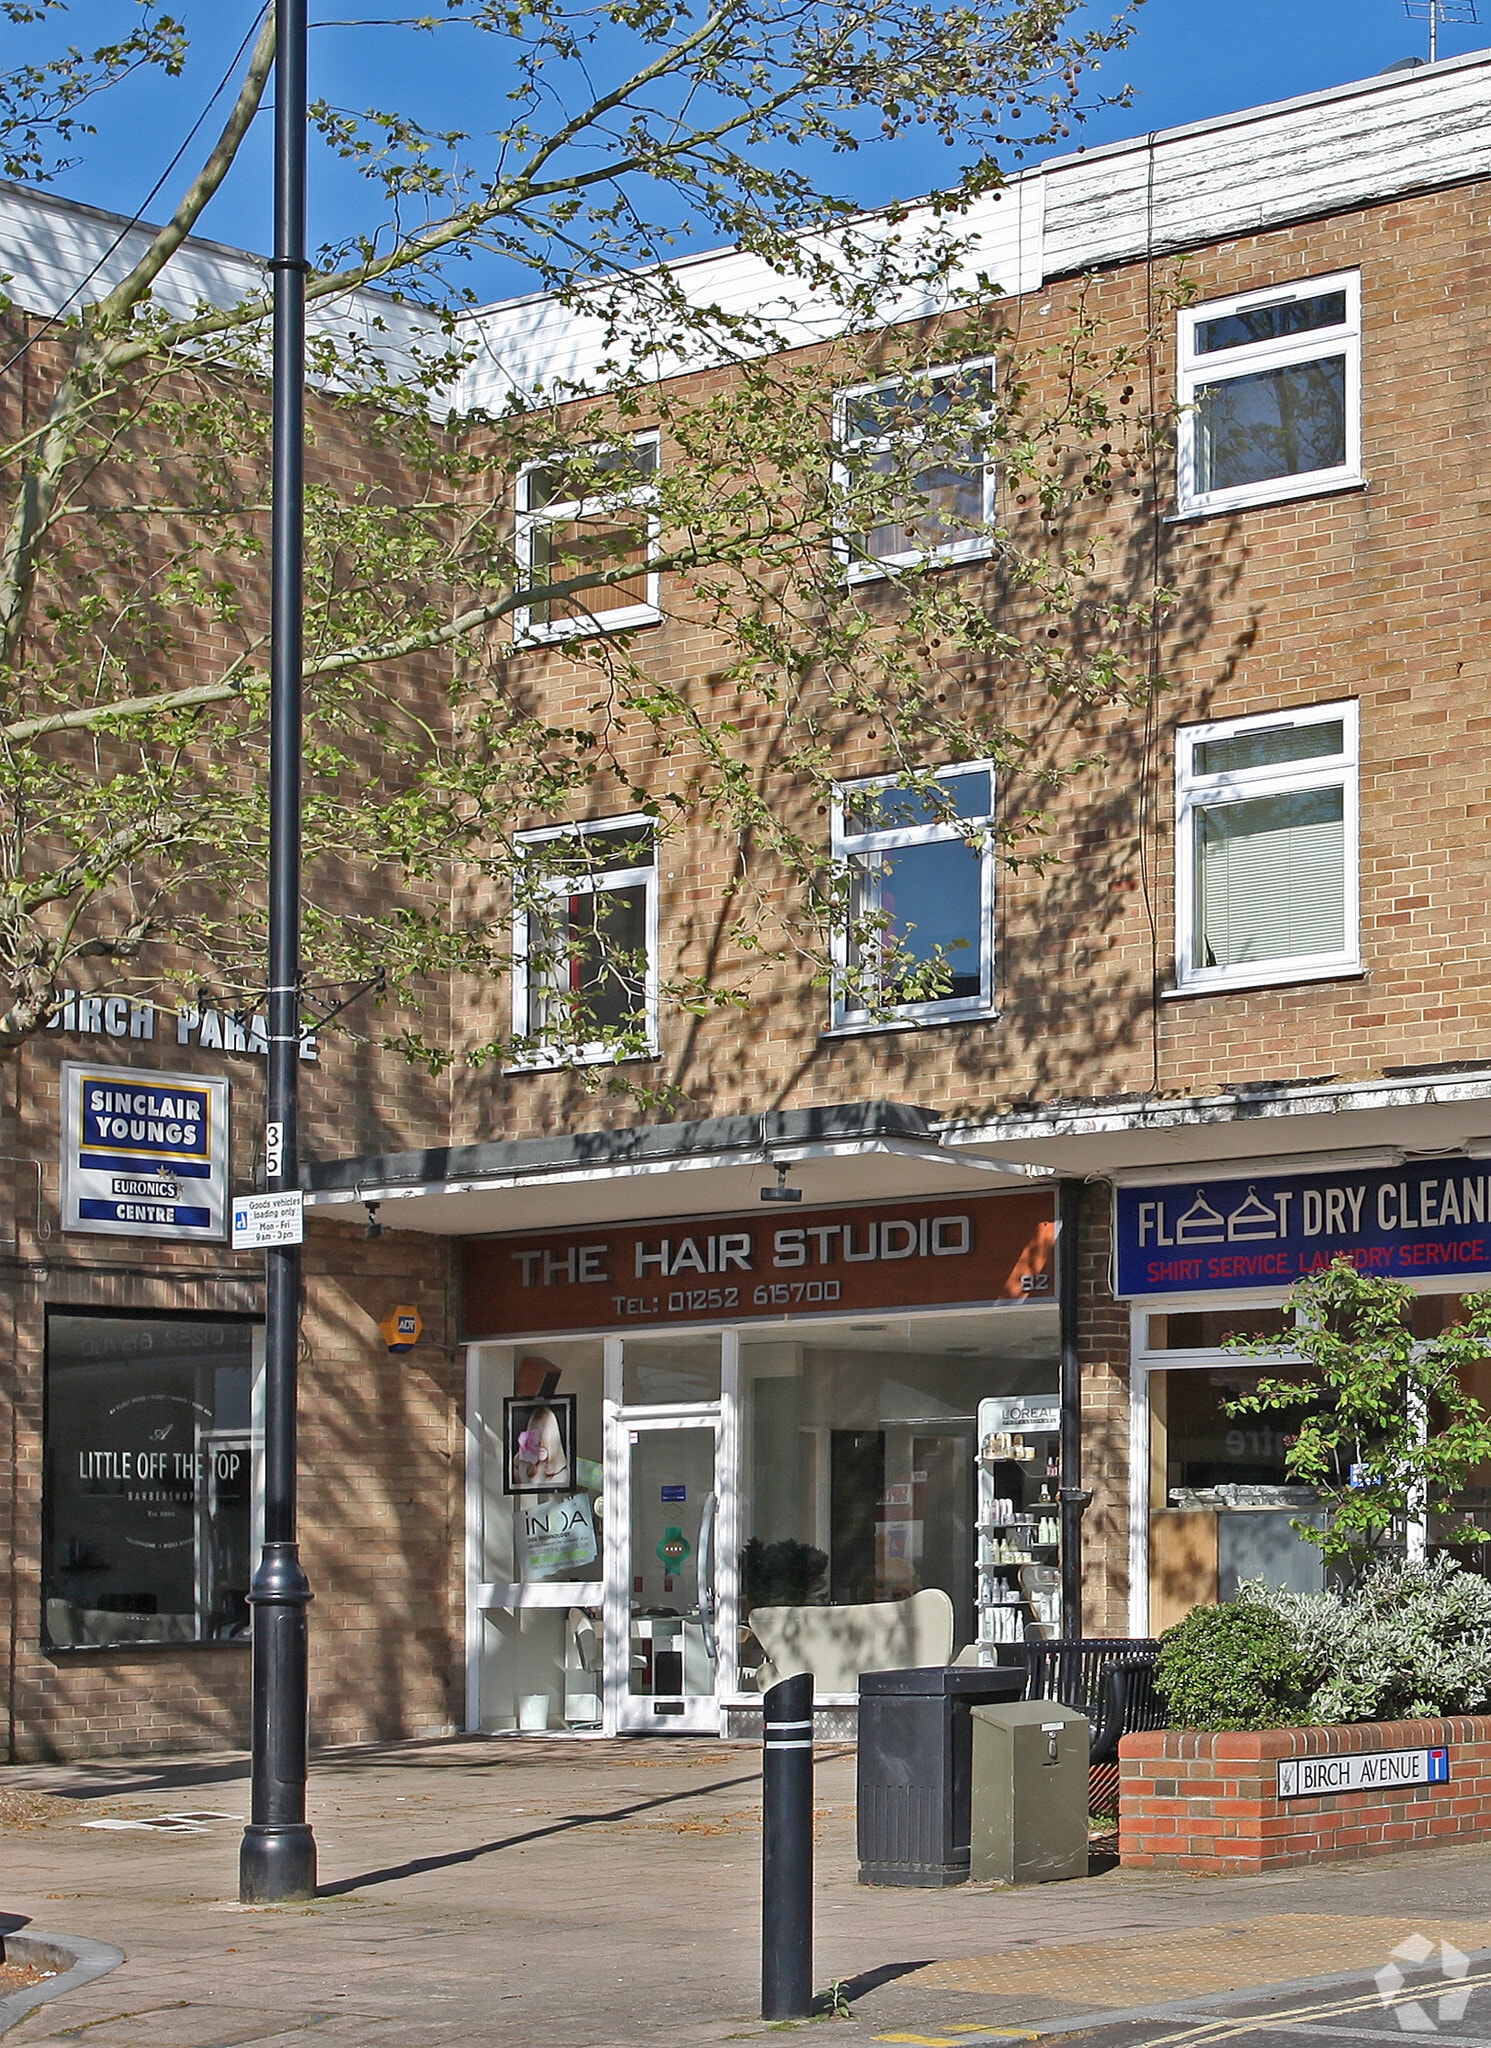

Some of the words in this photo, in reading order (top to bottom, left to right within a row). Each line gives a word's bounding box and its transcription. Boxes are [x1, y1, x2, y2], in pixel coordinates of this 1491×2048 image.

[90, 1090, 201, 1121] SINCLAIR
[95, 1116, 197, 1145] YOUNGS
[114, 1179, 176, 1197] EURONICS
[249, 1200, 271, 1210] Goods
[273, 1197, 301, 1208] vehicles
[1303, 1186, 1366, 1237] DRY
[116, 1204, 175, 1222] CENTRE
[253, 1210, 279, 1219] loading
[280, 1207, 296, 1217] only
[259, 1222, 275, 1231] Mon
[280, 1220, 291, 1229] Fri
[510, 1244, 609, 1287] THE
[634, 1232, 752, 1280] HAIR
[772, 1214, 972, 1269] STUDIO
[1146, 1258, 1202, 1284] SHIRT
[1020, 1273, 1049, 1291] 82
[668, 1287, 740, 1312] 01252
[753, 1280, 841, 1305] 615700
[398, 1319, 416, 1331] ADT
[148, 1423, 174, 1441] A
[79, 1451, 133, 1480] LITTLE
[137, 1452, 168, 1480] OFF
[173, 1453, 205, 1480] THE
[207, 1453, 241, 1480] TOP
[128, 1490, 195, 1502] BARBERSHOP
[1304, 1762, 1351, 1790] BIRCH
[1359, 1755, 1421, 1784] AVENUE
